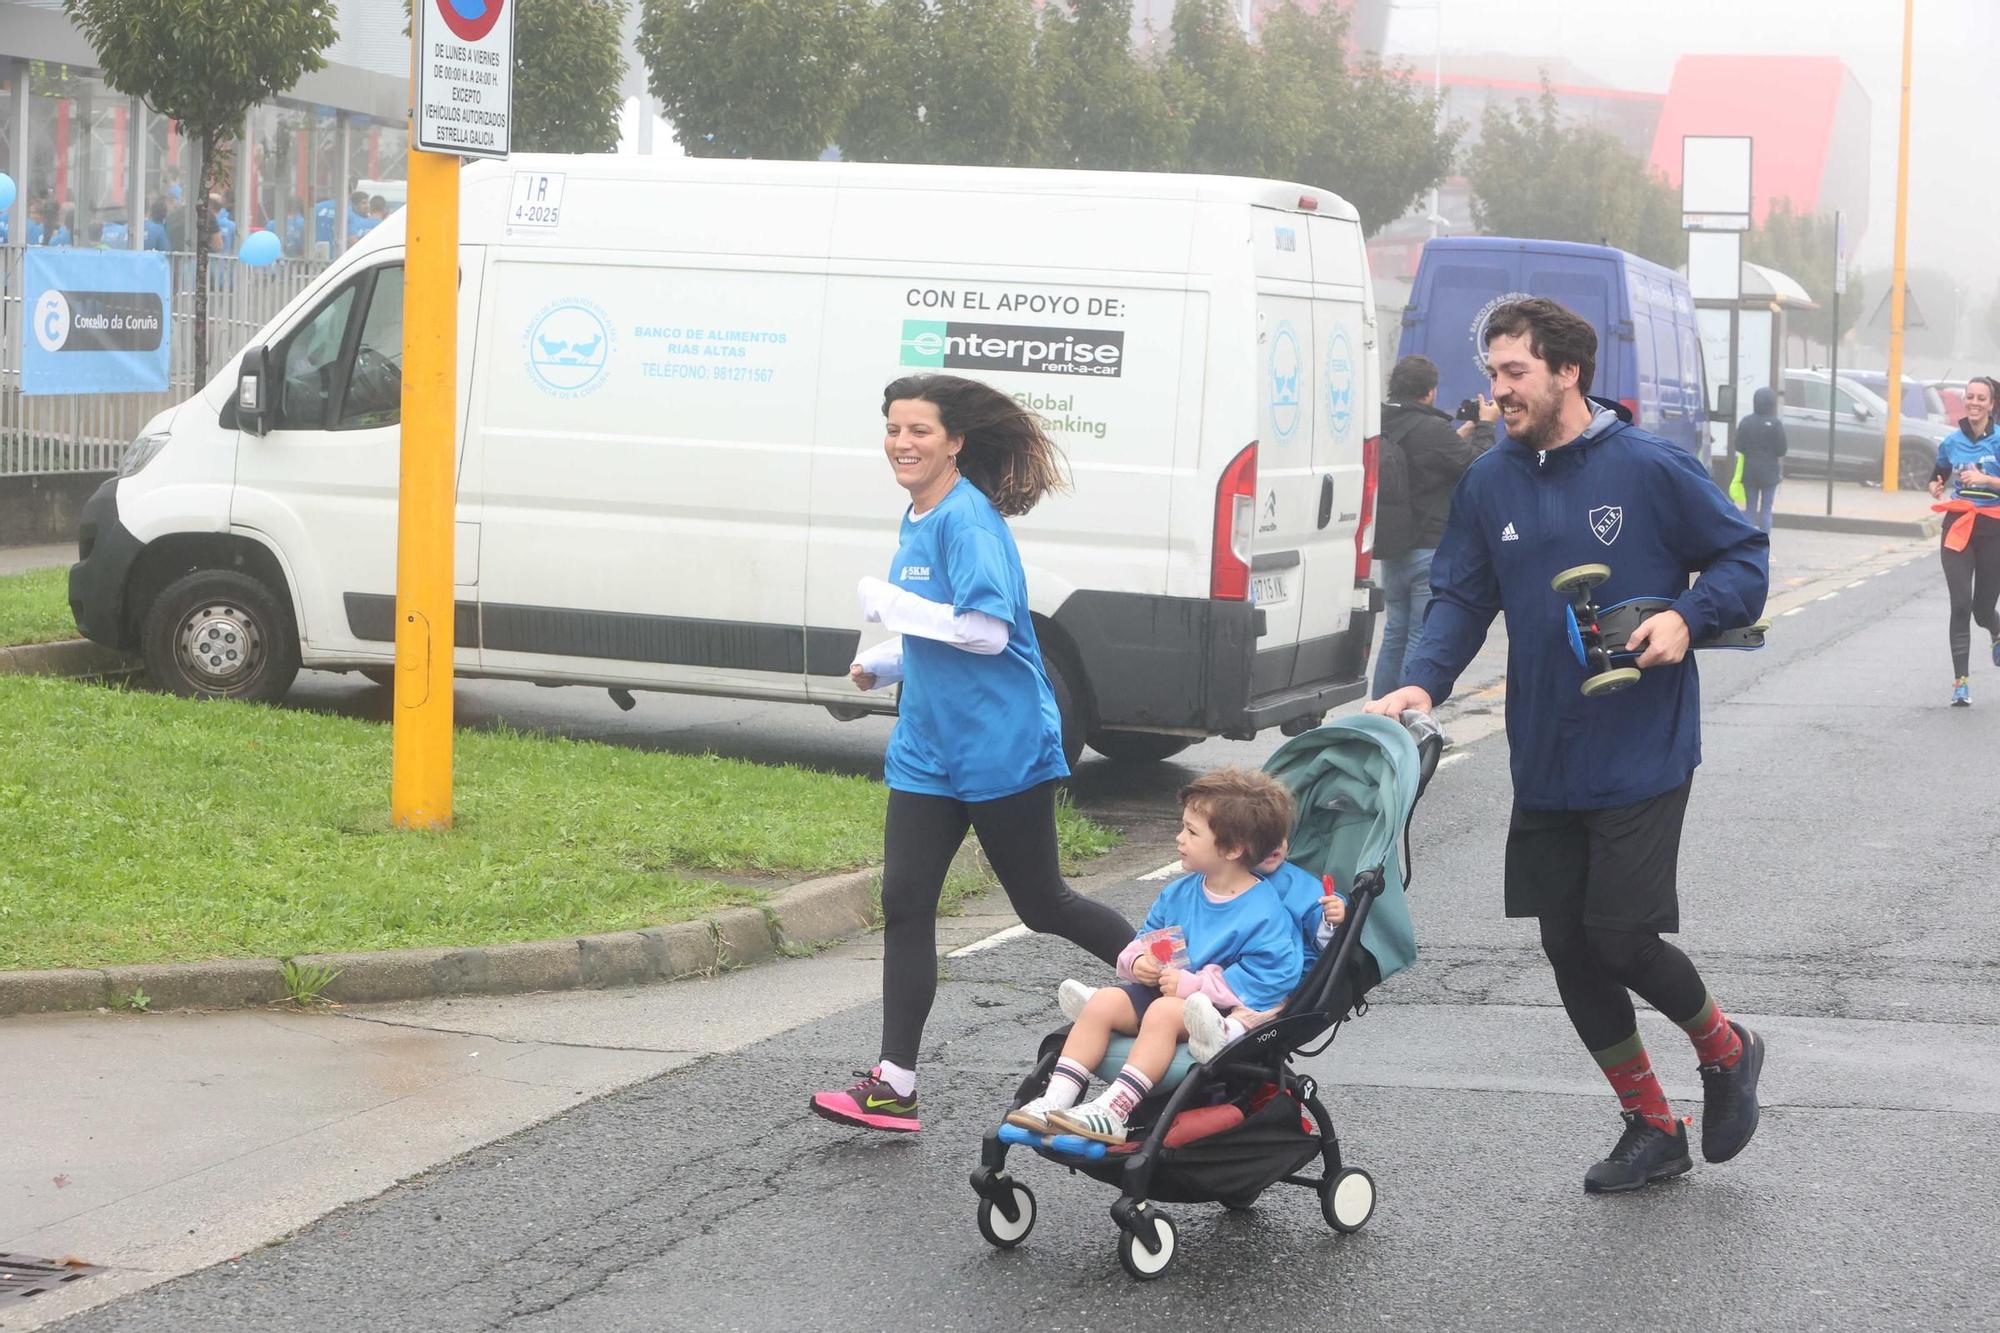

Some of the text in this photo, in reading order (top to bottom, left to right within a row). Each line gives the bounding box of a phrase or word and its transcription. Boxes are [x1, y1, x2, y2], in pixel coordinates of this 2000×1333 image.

[435, 44, 500, 67] DE LUNES A VIERNES
[434, 65, 443, 78] DE
[470, 69, 475, 83] A
[475, 70, 491, 86] 24:00
[452, 87, 481, 104] EXCEPTO
[462, 108, 506, 128] AUTORIZADOS
[437, 126, 495, 146] ESTRELLA GALICIA
[515, 205, 559, 223] 4-2025
[906, 288, 1126, 317] CON EL APOYO DE:
[75, 314, 158, 330] Concello da Coruña
[634, 326, 787, 344] BANCO DE ALIMENTOS
[668, 343, 746, 358] RIAS ALTAS
[913, 333, 1121, 367] enterprise
[641, 361, 774, 383] TELÉFONO: 981271567
[1041, 362, 1118, 376] rent-a-car
[1012, 392, 1074, 412] Global
[1040, 414, 1107, 439] anking
[1597, 511, 1620, 533] D.I.F.
